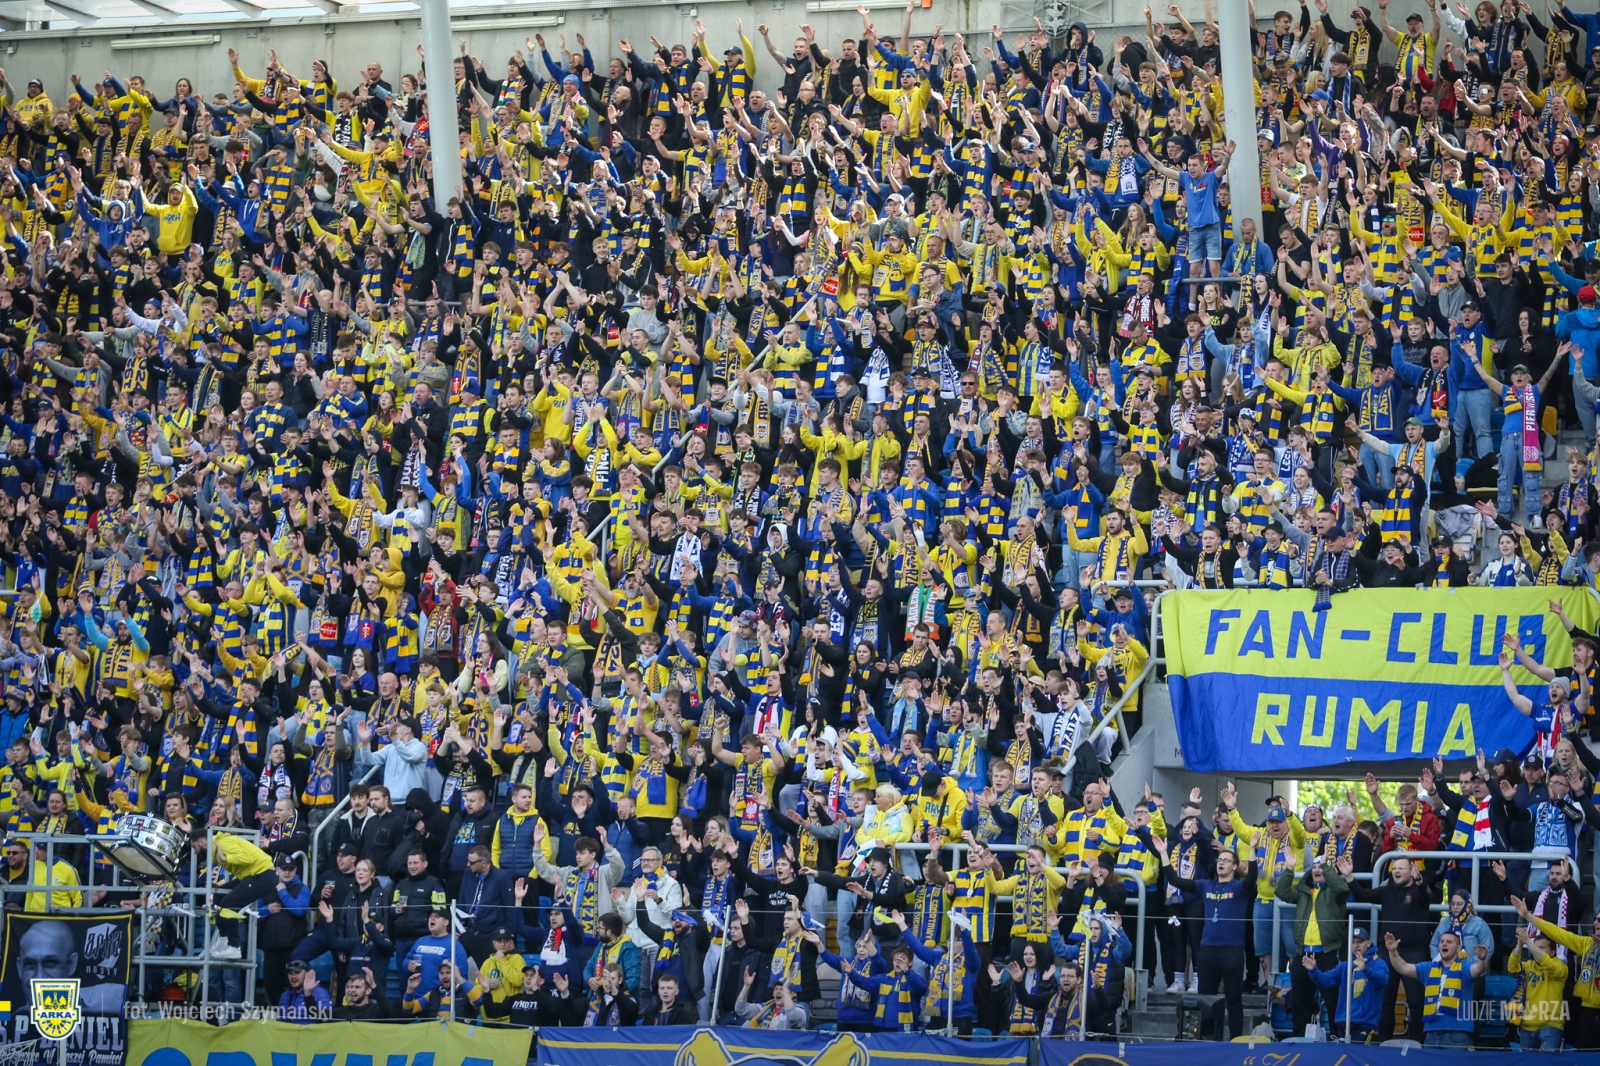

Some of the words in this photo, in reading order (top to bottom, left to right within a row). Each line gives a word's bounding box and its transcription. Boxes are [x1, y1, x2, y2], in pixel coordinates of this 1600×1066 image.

[1250, 692, 1477, 757] RUMIA
[581, 882, 594, 934] MZKS
[1030, 879, 1043, 931] MZKS
[86, 965, 118, 976] MOSTY
[56, 1050, 86, 1066] aszej
